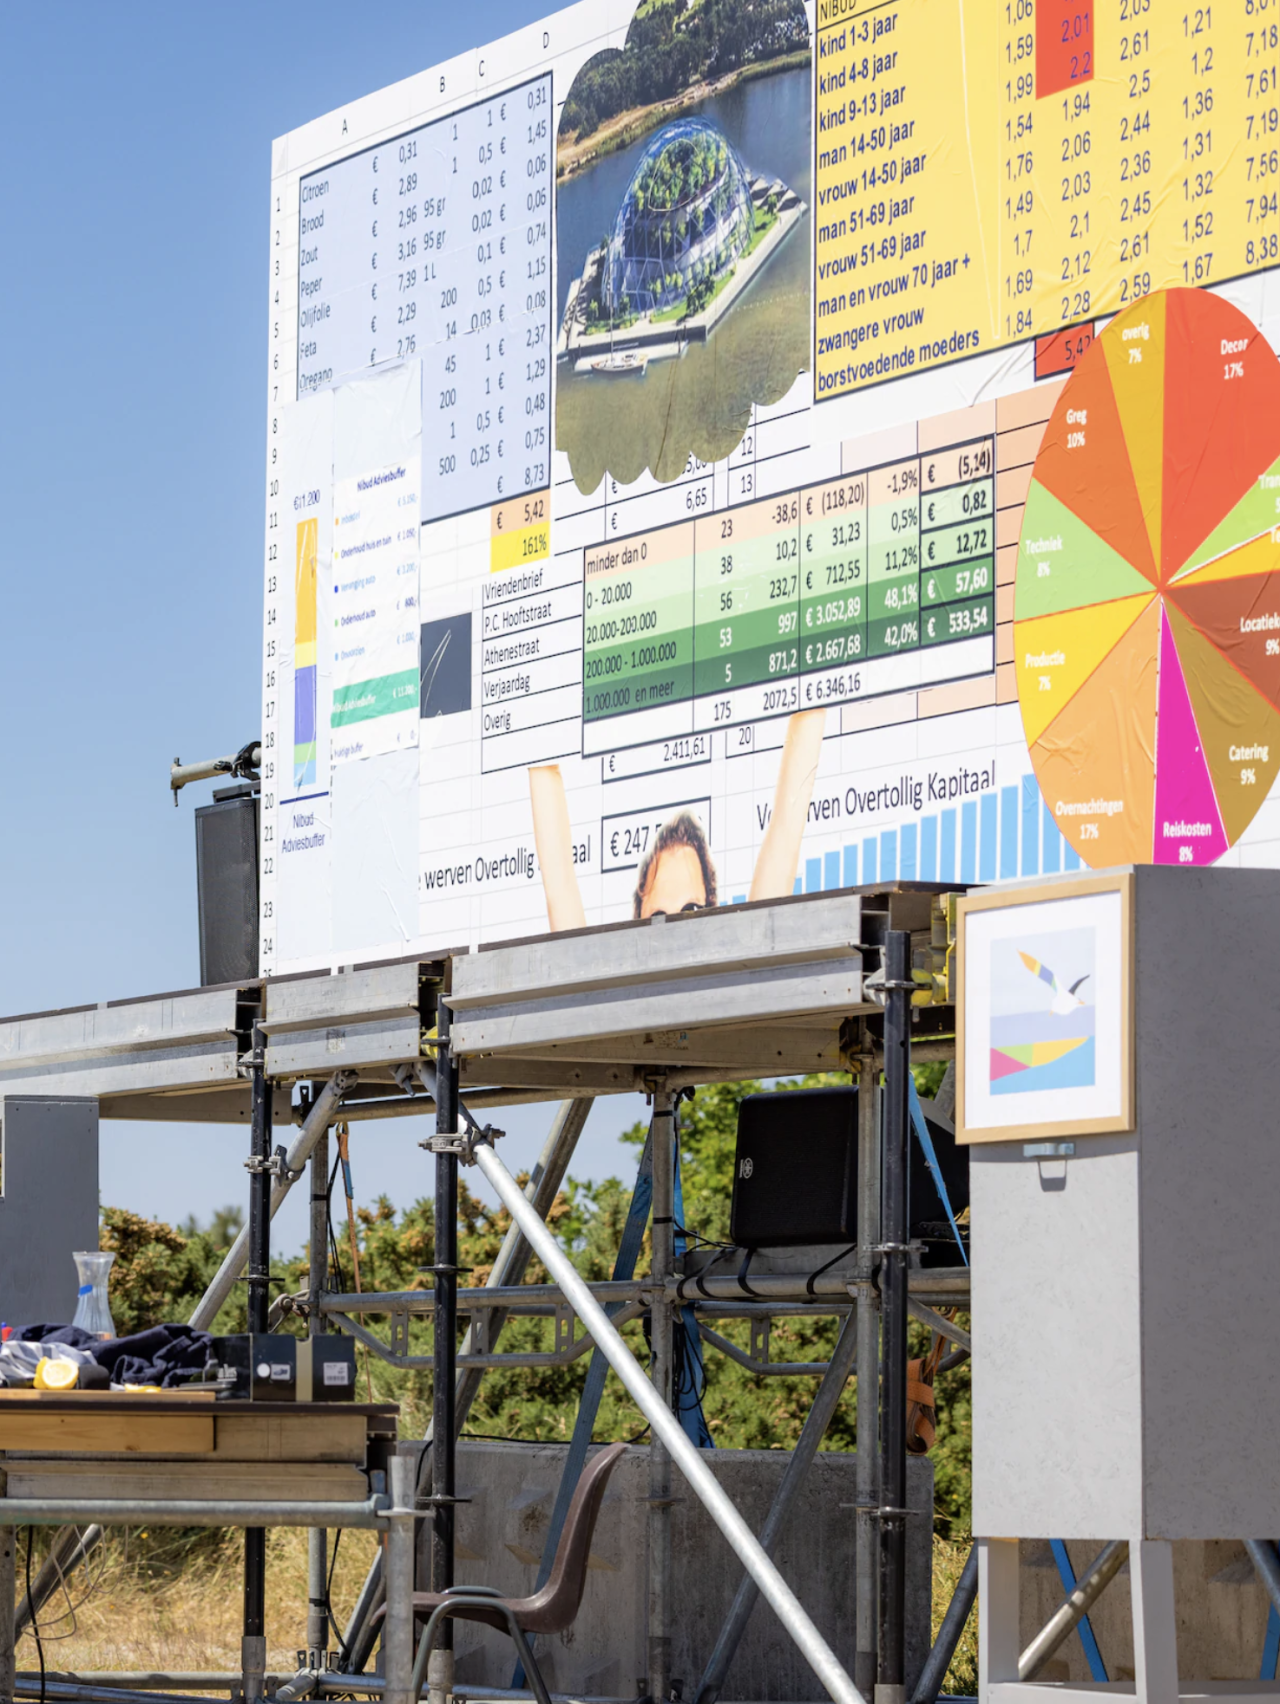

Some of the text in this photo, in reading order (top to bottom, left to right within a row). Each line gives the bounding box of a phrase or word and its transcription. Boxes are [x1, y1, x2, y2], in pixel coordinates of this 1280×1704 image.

[1006, 0, 1033, 26] 1,06
[1183, 6, 1211, 39] 1,21
[543, 32, 550, 48] D
[820, 13, 898, 58] kind 1-3 jaar
[1061, 12, 1090, 43] 2,01
[819, 51, 898, 96] kind 4-8 jaar
[1129, 69, 1150, 99] 2,5
[1245, 65, 1278, 100] 7,61
[527, 87, 547, 110] 0,31
[1006, 72, 1033, 104] 1,99
[819, 85, 906, 132] kind 9-13 jaar
[1062, 90, 1090, 123] 1,94
[1183, 88, 1213, 120] 1,36
[342, 119, 348, 135] A
[399, 141, 417, 163] 0,31
[819, 120, 915, 170] man 14-50 jaar
[1006, 151, 1033, 182] 1,76
[1120, 150, 1151, 183] 2,36
[1245, 149, 1278, 183] 7,56
[302, 179, 329, 203] Citroen
[819, 153, 926, 206] vrouw 14-50 jaar
[1061, 170, 1091, 201] 2,03
[1183, 170, 1213, 202] 1,32
[399, 207, 417, 228] 2,96
[424, 197, 446, 218] 95 gr
[819, 196, 915, 244] man 51-69 jaar
[301, 212, 324, 235] Brood
[527, 222, 546, 245] 0,74
[819, 229, 926, 281] vrouw 51-69 jaar
[1014, 229, 1032, 258] 1,7
[1120, 231, 1150, 263] 2,61
[1245, 234, 1279, 267] 8,38
[301, 247, 318, 267] Zout
[1061, 250, 1091, 282] 2,12
[1183, 252, 1213, 285] 1,67
[301, 277, 322, 298] Peper
[398, 269, 416, 291] 7,39
[819, 257, 958, 318] man en vrouw 70 jaar
[300, 303, 331, 328] Olijfolie
[1061, 290, 1091, 321] 2,28
[818, 307, 924, 355] zwangere vrouw
[1122, 322, 1150, 341] overig
[397, 335, 416, 358] 2,76
[1128, 348, 1142, 364] 7%
[1220, 338, 1249, 357] Decor
[527, 359, 545, 382] 1,29
[818, 329, 980, 392] borstvoedende moeders
[1223, 362, 1244, 380] 17%
[299, 368, 333, 391] Oregano
[1066, 409, 1087, 425] Greg
[1067, 432, 1085, 448] 10%
[439, 455, 456, 476] 500
[470, 444, 490, 467] 0,25
[958, 449, 991, 476] (5,14)
[525, 463, 544, 487] 8,73
[741, 474, 753, 494] 13
[887, 469, 918, 495] -1,9%
[270, 480, 279, 497] 10
[686, 487, 707, 510] 6,65
[821, 482, 865, 515] (118,20)
[524, 499, 544, 523] 5,42
[772, 500, 798, 525] -38,6
[962, 490, 987, 514] 0,82
[721, 519, 733, 539] 23
[891, 507, 918, 531] 0,5%
[522, 533, 547, 557] 161%
[832, 522, 861, 547] 31,23
[956, 528, 987, 554] 12,72
[1025, 535, 1063, 555] Techniek
[587, 542, 647, 575] minder dan 0
[776, 538, 797, 562] 10,2
[885, 545, 918, 572] 11,2%
[826, 559, 861, 585] 712,55
[956, 567, 988, 594] 57,60
[1037, 561, 1051, 578] 8%
[485, 569, 543, 600] Vriendenbrief
[601, 581, 632, 605] 20.000
[770, 575, 797, 600] 232,7
[884, 584, 918, 610] 48,1%
[485, 602, 552, 631] P.C. Hooftstraat
[806, 596, 861, 628] € 3.052,89
[949, 606, 988, 633] 533,54
[884, 622, 918, 647] 42,0%
[484, 638, 540, 666] Athenestraat
[586, 641, 677, 679] 200.000 1.000.000
[769, 649, 797, 673] 871,2
[806, 634, 861, 664] € 2.667,68
[1025, 650, 1065, 669] Productie
[484, 673, 530, 698] Verjaardag
[806, 672, 861, 701] € 6.346,16
[1038, 675, 1051, 691] 7%
[585, 680, 674, 714] 1.000.000 en meer
[763, 686, 797, 712] 2072,5
[484, 711, 511, 731] Overig
[714, 700, 732, 721] 175
[739, 727, 751, 746] 20
[663, 737, 705, 762] 2.411,61
[1229, 743, 1269, 762] Catering
[845, 775, 923, 815] Overtollig
[928, 759, 995, 802] Kapitaal
[1241, 768, 1256, 785] 9%
[264, 793, 274, 809] 20
[1055, 798, 1123, 816] Overnachtingen
[293, 812, 314, 829] Nibud
[1080, 824, 1099, 840] 17%
[1163, 821, 1212, 838] Reiskosten
[282, 832, 325, 854] Adviesbuffer
[1178, 846, 1193, 862] 8%
[425, 864, 472, 890] werven
[475, 848, 535, 882] Overtollig
[263, 938, 272, 954] 24
